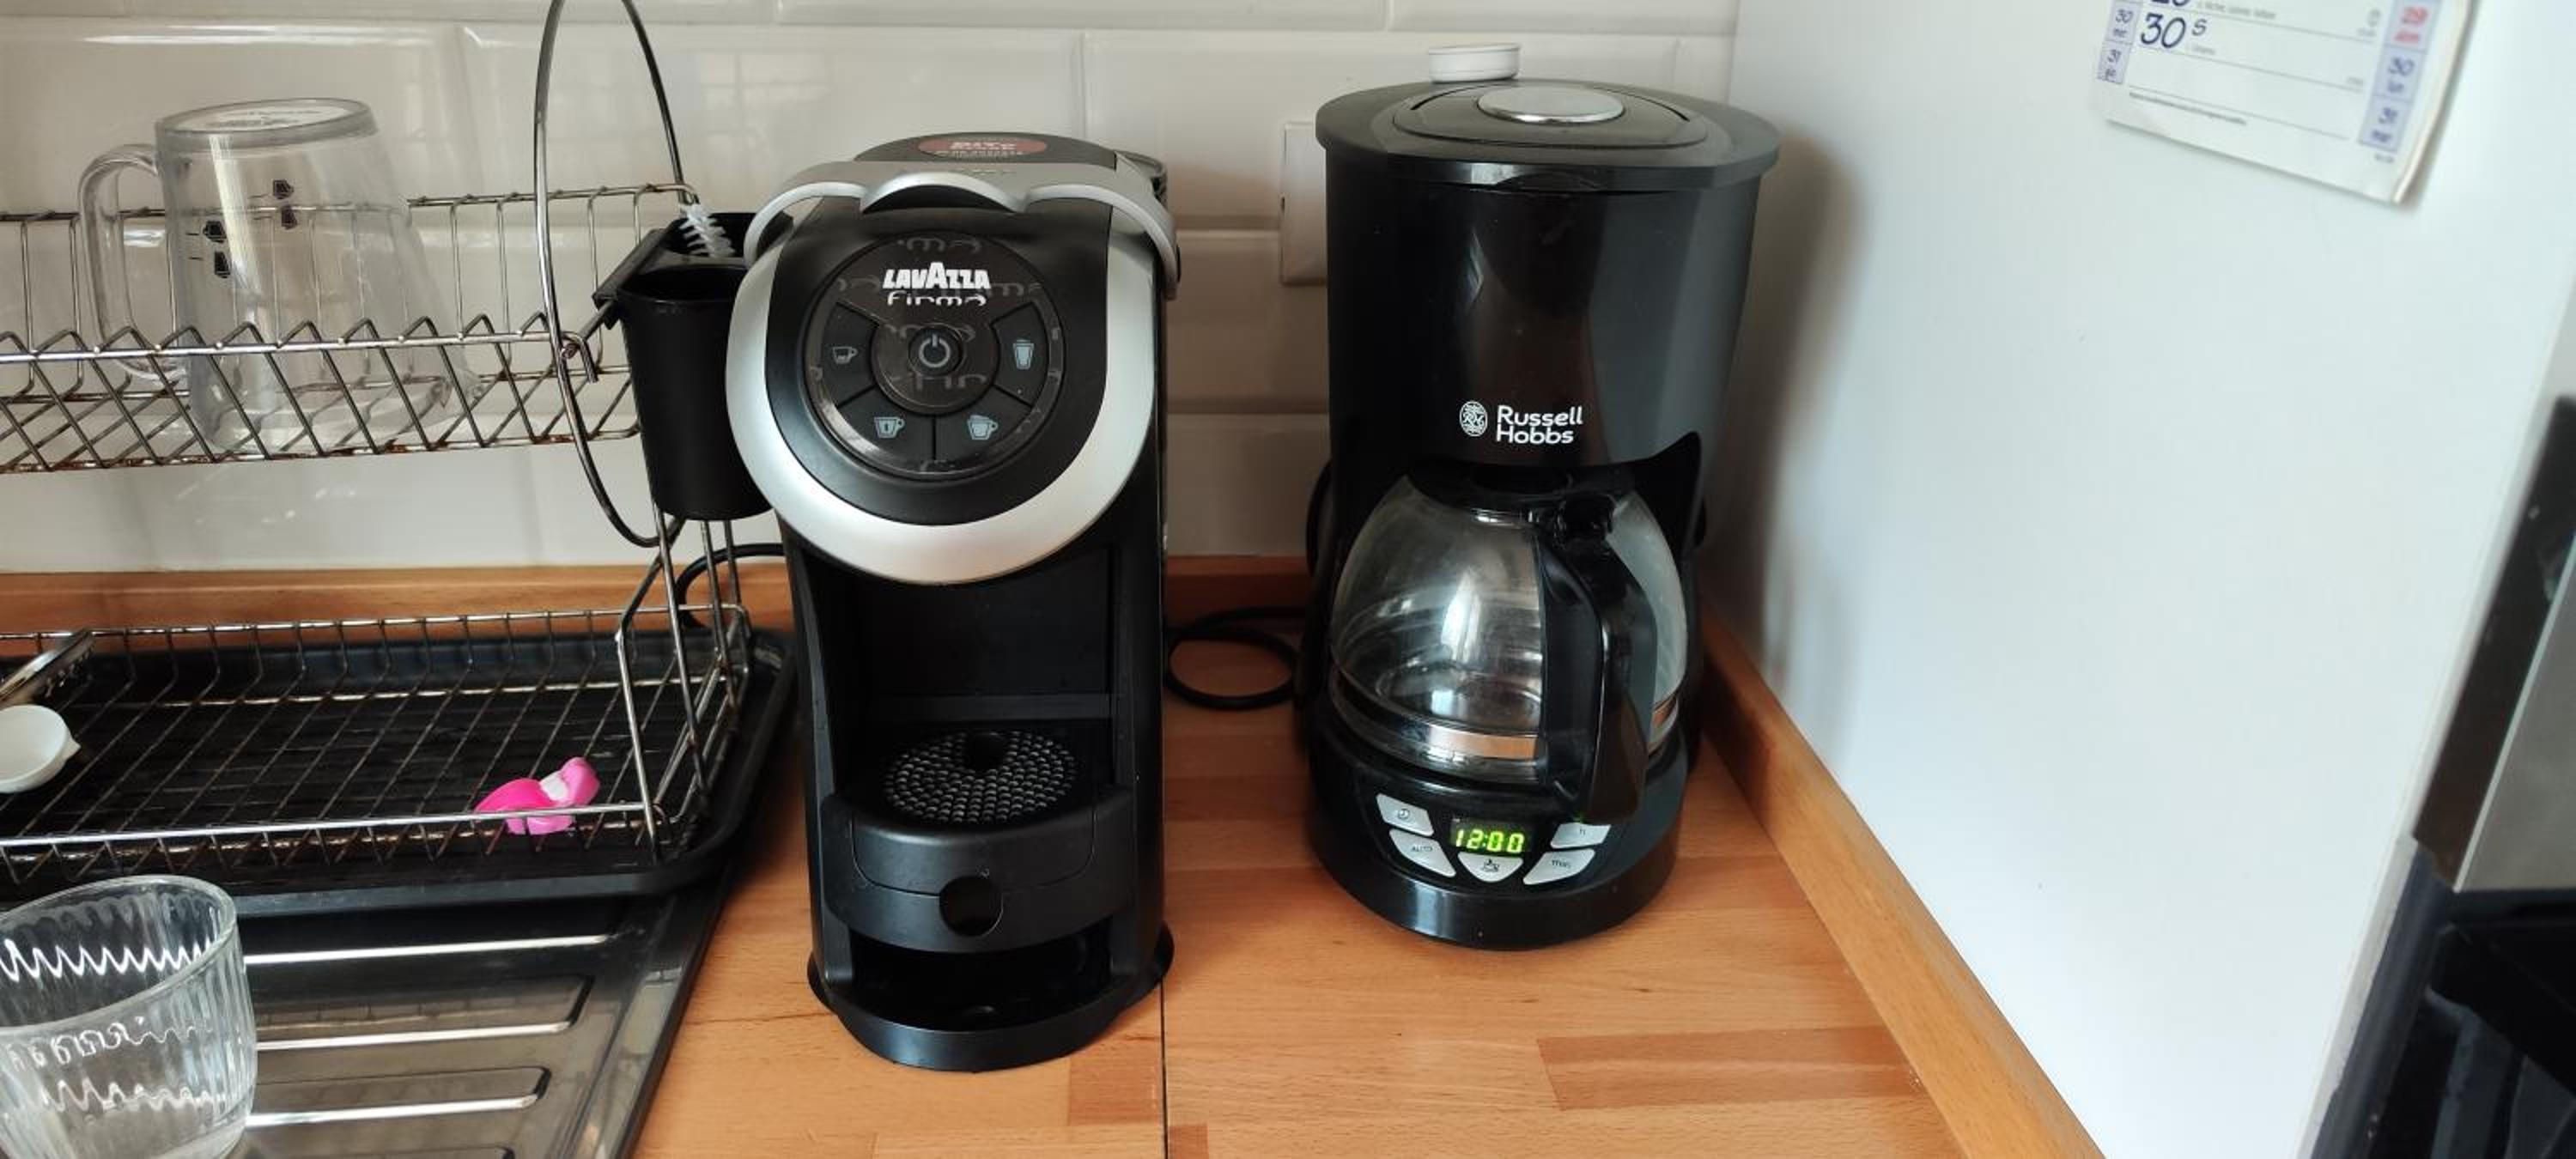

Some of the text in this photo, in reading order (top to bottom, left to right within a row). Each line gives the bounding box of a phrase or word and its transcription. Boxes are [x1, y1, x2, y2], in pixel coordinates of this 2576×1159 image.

[2141, 12, 2186, 49] 30
[882, 262, 992, 289] LAVAZZA
[1497, 404, 1583, 427] Russell
[1497, 423, 1574, 444] Hobbs
[1455, 828, 1525, 854] 12:00
